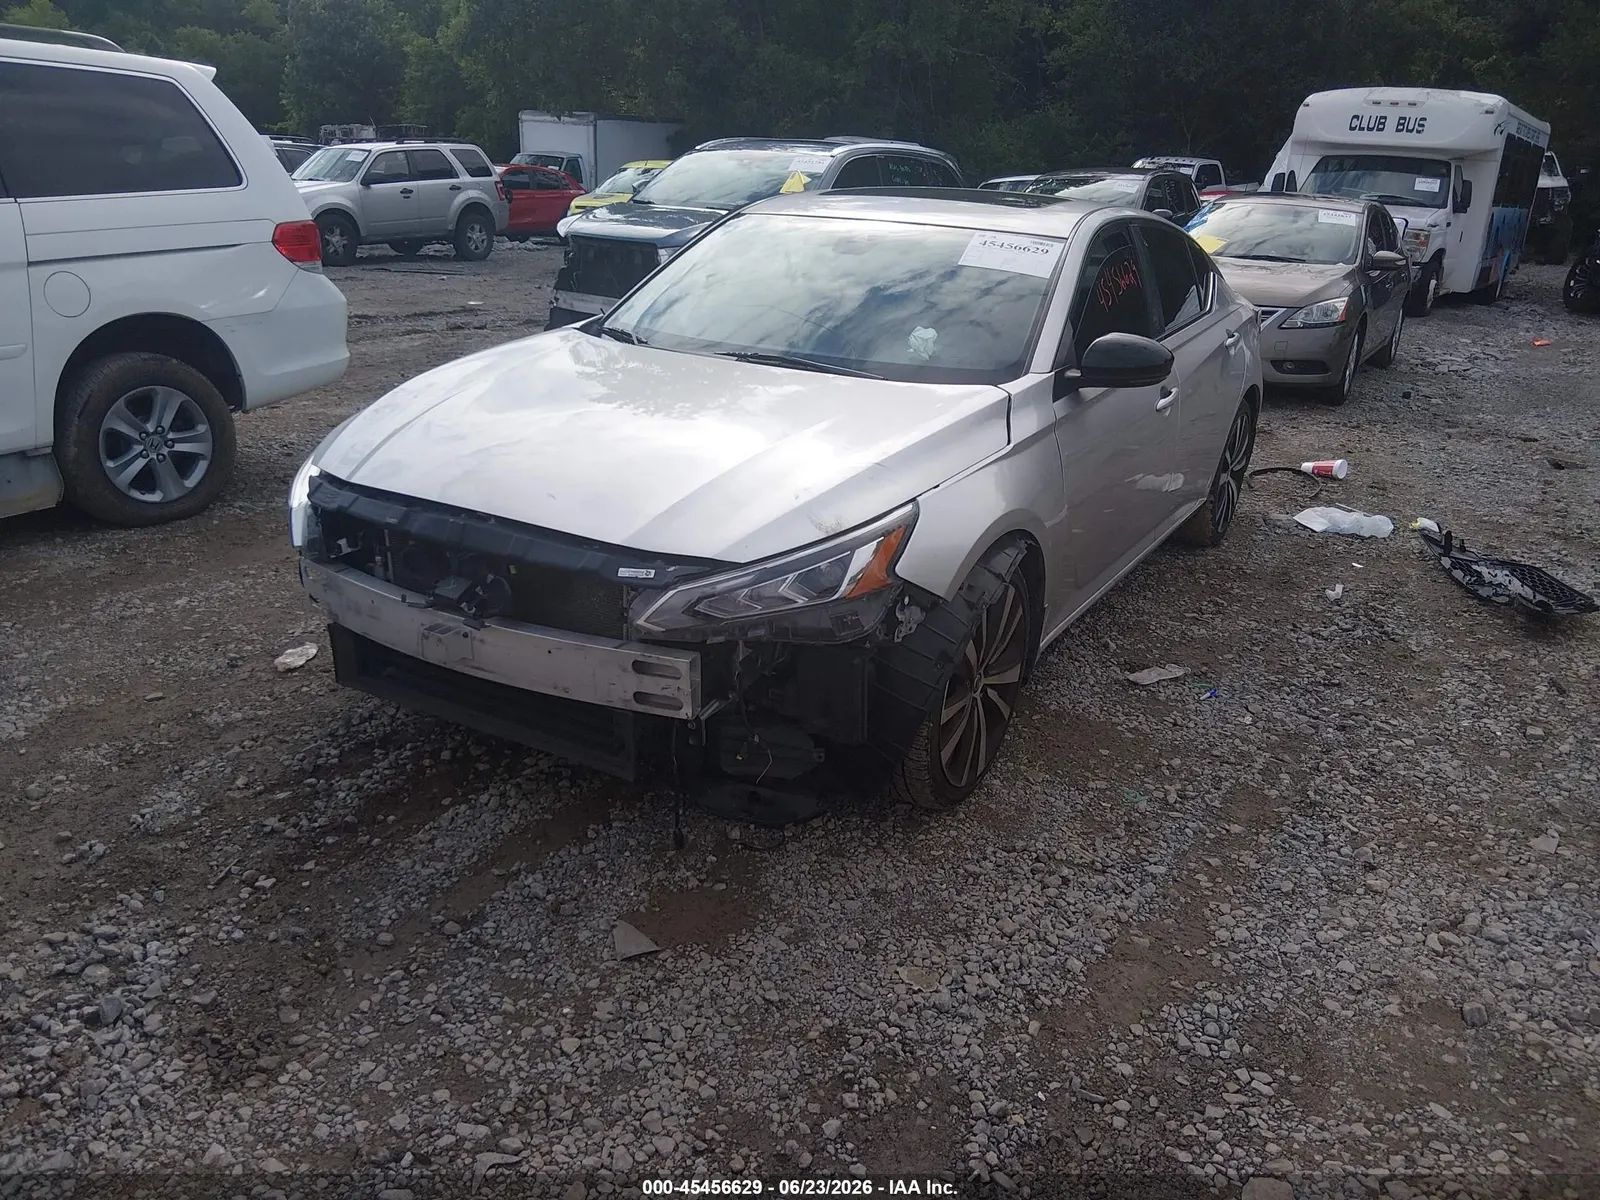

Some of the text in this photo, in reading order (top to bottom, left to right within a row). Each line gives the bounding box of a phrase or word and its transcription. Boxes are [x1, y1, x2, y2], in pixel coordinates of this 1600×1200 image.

[1349, 115, 1427, 134] CLUB BUS
[979, 240, 1049, 255] 45456629
